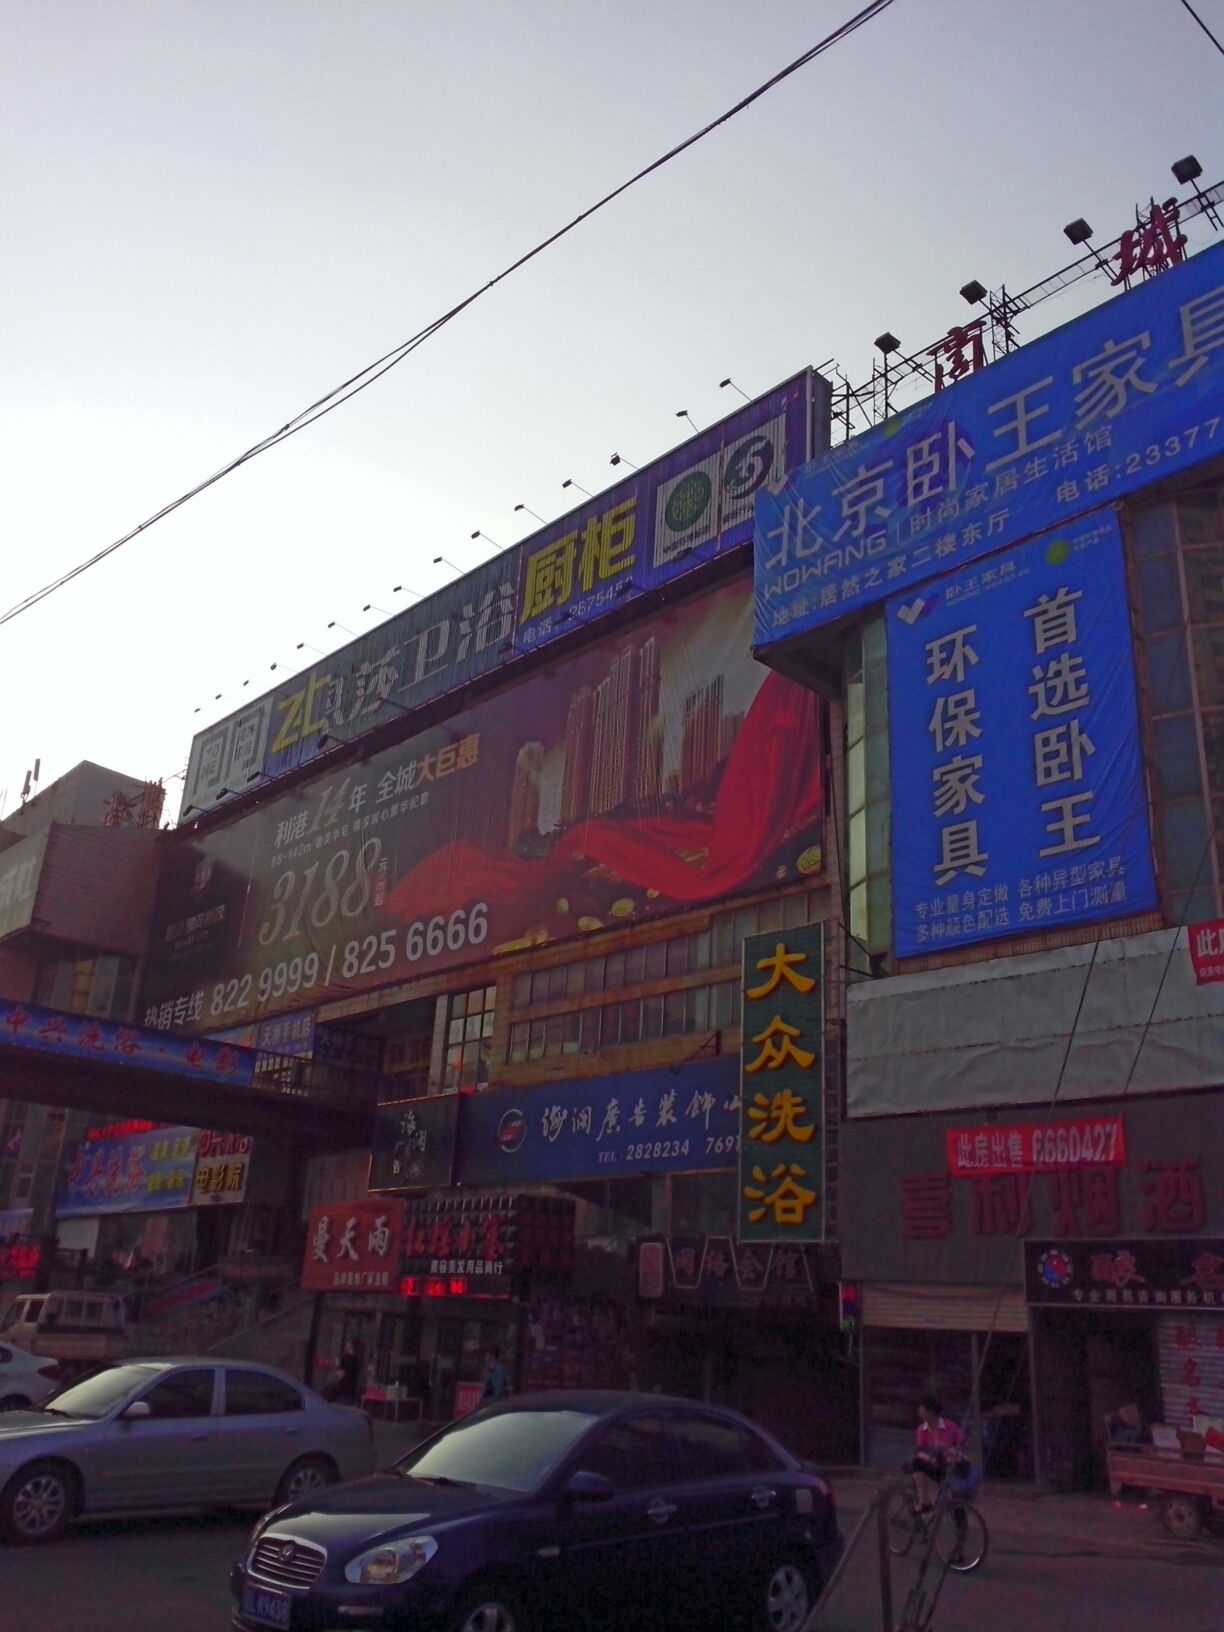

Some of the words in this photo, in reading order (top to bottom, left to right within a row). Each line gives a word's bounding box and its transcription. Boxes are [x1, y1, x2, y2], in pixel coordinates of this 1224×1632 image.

[909, 423, 1114, 535] 时尚家居生活馆
[519, 496, 638, 624] 厨柜
[763, 527, 888, 600] WOWANG
[375, 733, 481, 804] 全城大巨惠
[924, 624, 989, 886] 环保家具
[1023, 586, 1101, 859] 首选卧王
[259, 837, 382, 945] 3188
[1016, 855, 1126, 897] 各种异型家具
[210, 973, 253, 1017] 822
[257, 951, 319, 1003] 9999
[341, 929, 397, 978] 825
[405, 902, 489, 962] 6666
[1197, 928, 1224, 957] 此
[744, 942, 816, 1224] 大众洗浴
[626, 1139, 690, 1161] 2828234
[957, 1129, 1024, 1170] 此房出售
